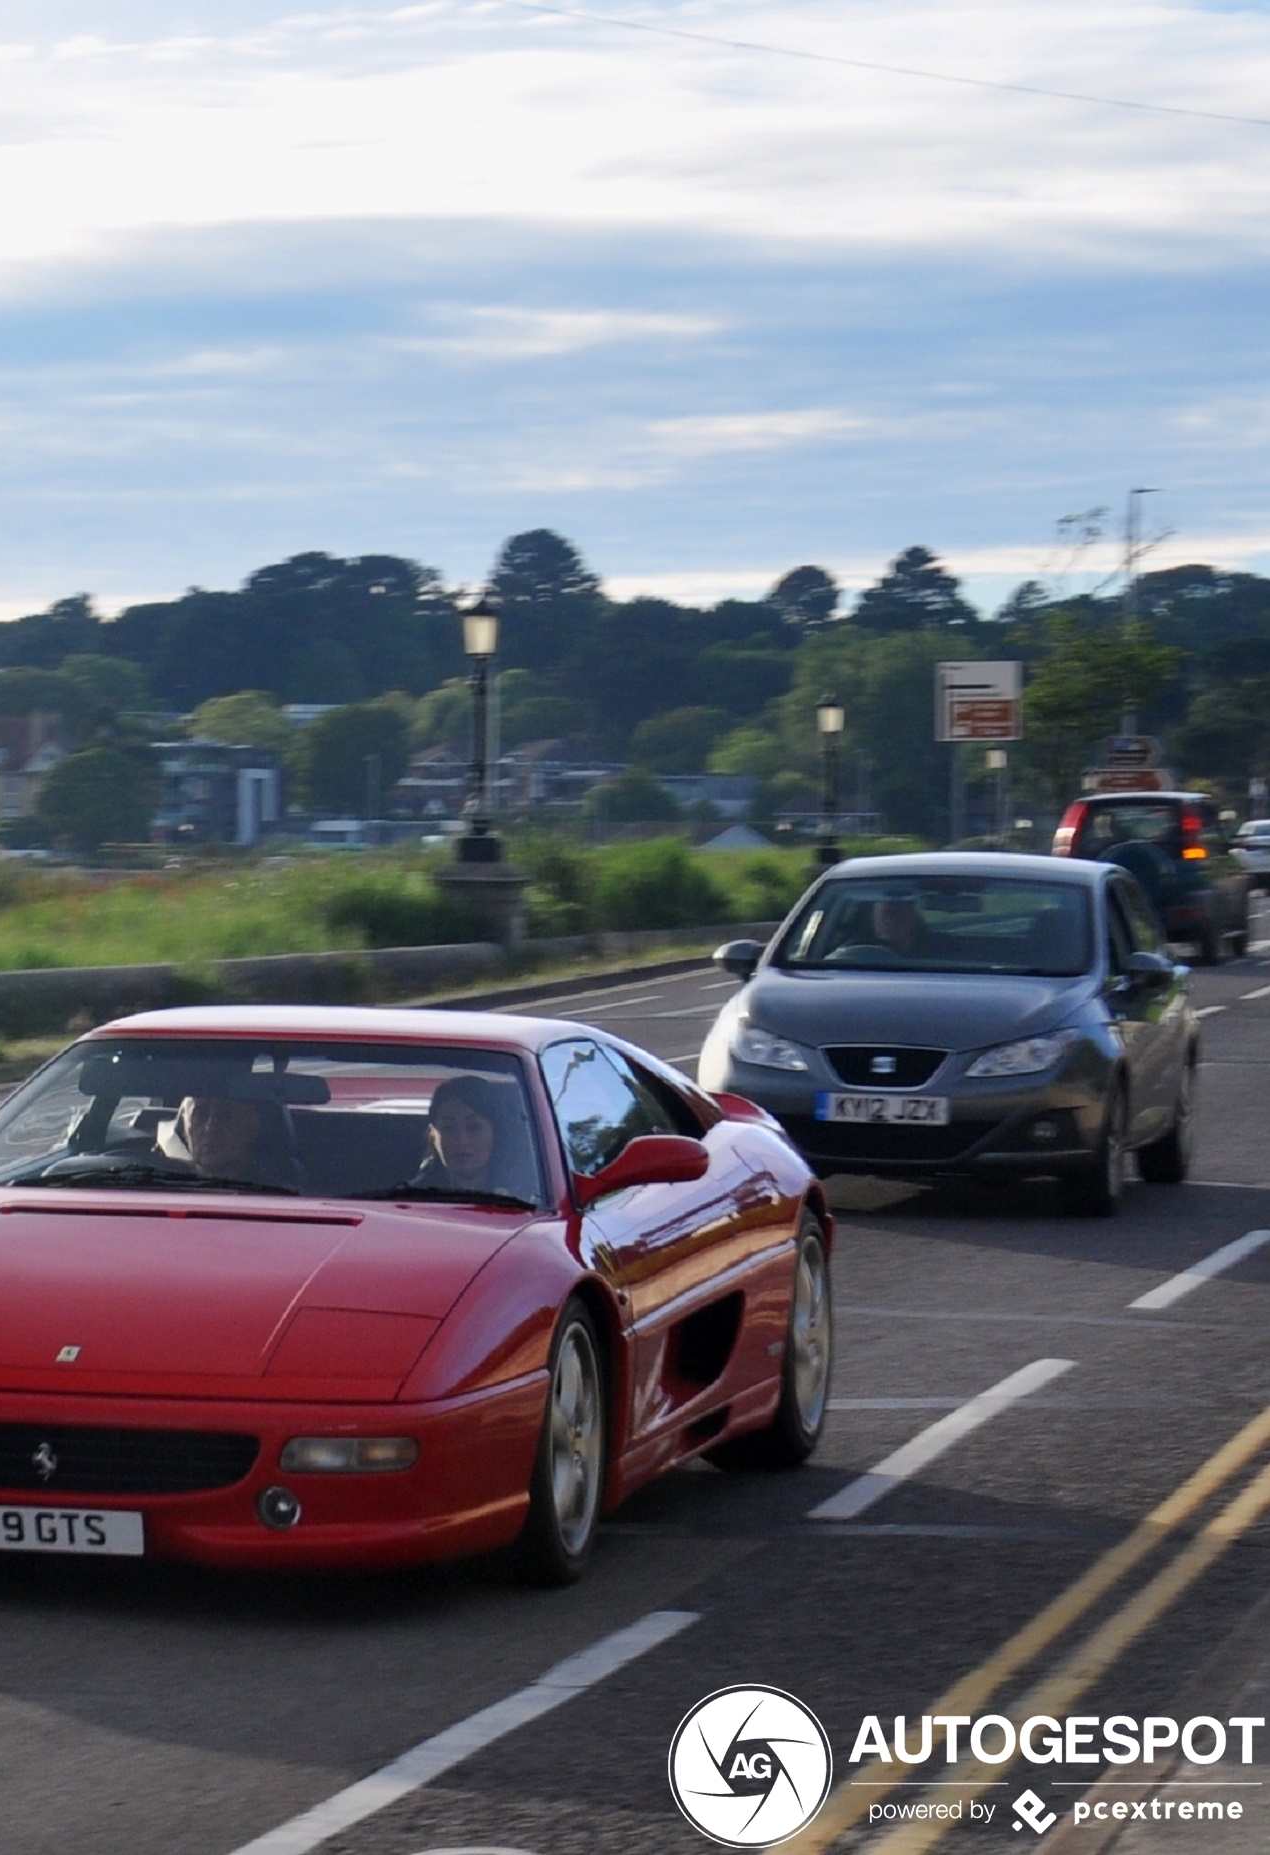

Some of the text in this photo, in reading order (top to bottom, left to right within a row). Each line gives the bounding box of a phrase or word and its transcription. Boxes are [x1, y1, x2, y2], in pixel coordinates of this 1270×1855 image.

[836, 1097, 940, 1121] KY12 JZX
[35, 1511, 106, 1546] GTS
